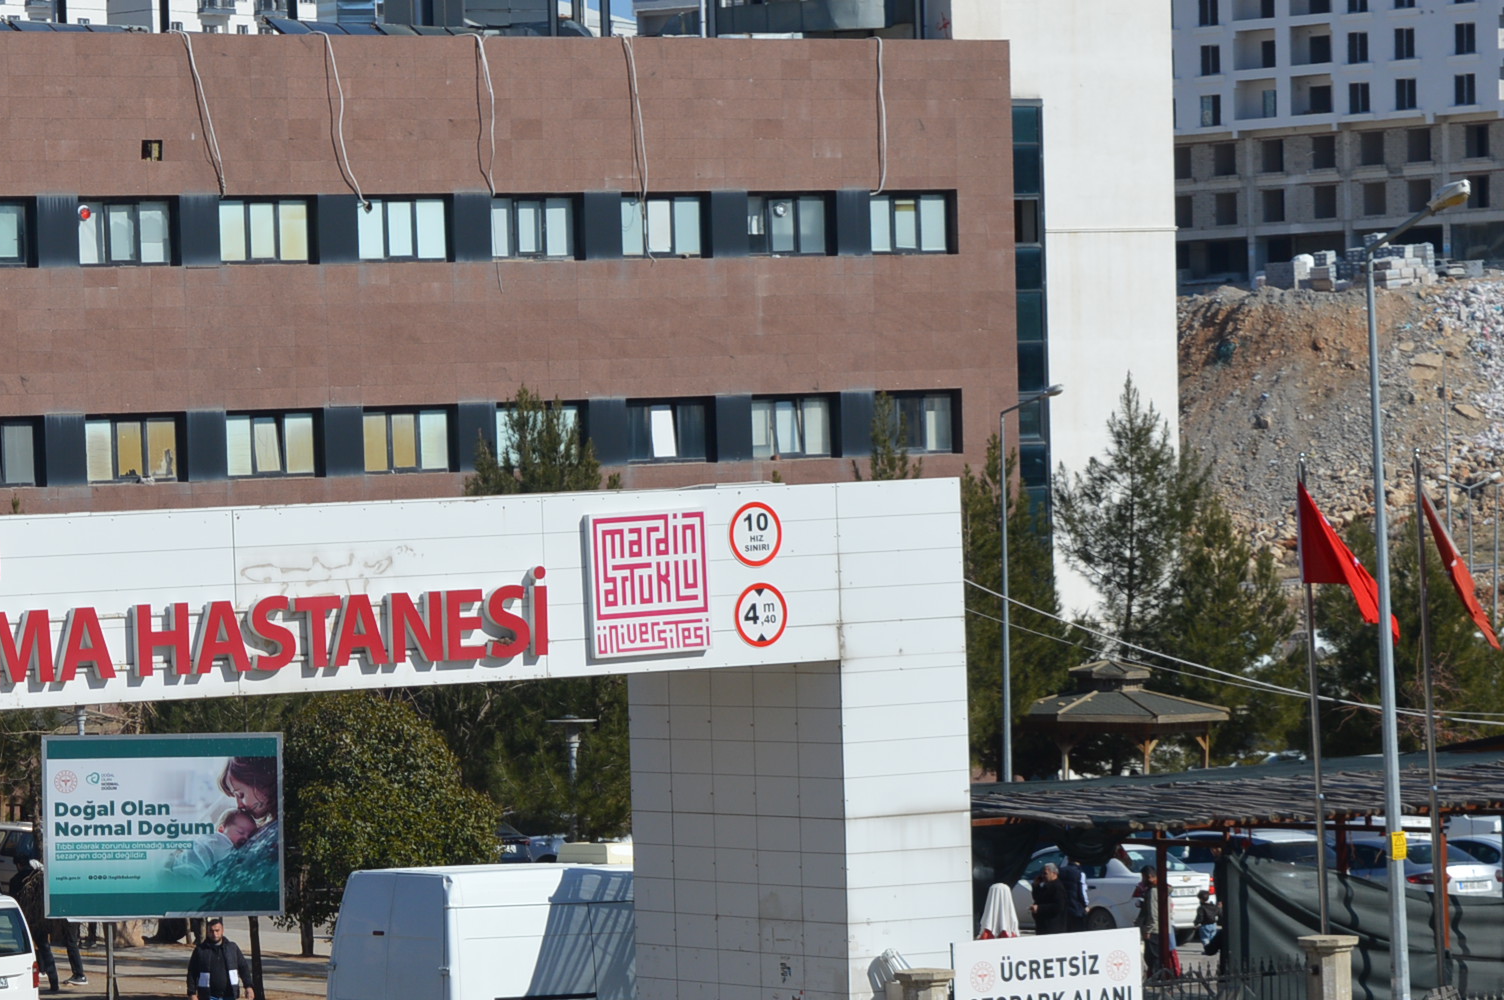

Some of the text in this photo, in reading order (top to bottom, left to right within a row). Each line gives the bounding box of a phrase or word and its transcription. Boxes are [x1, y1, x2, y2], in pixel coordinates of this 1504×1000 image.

[743, 512, 769, 532] 10
[744, 544, 770, 552] SINIRI
[749, 535, 764, 543] HIZ
[137, 567, 549, 677] HASTANESİ
[744, 603, 759, 625] 4
[54, 799, 170, 820] Doğal Olan
[54, 818, 215, 839] Normal Doğum
[131, 841, 165, 850] olmadığı
[166, 841, 192, 849] sürece
[56, 853, 90, 861] sezaryen
[92, 851, 114, 860] doğal
[1000, 951, 1099, 982] ÜCRETSİZ
